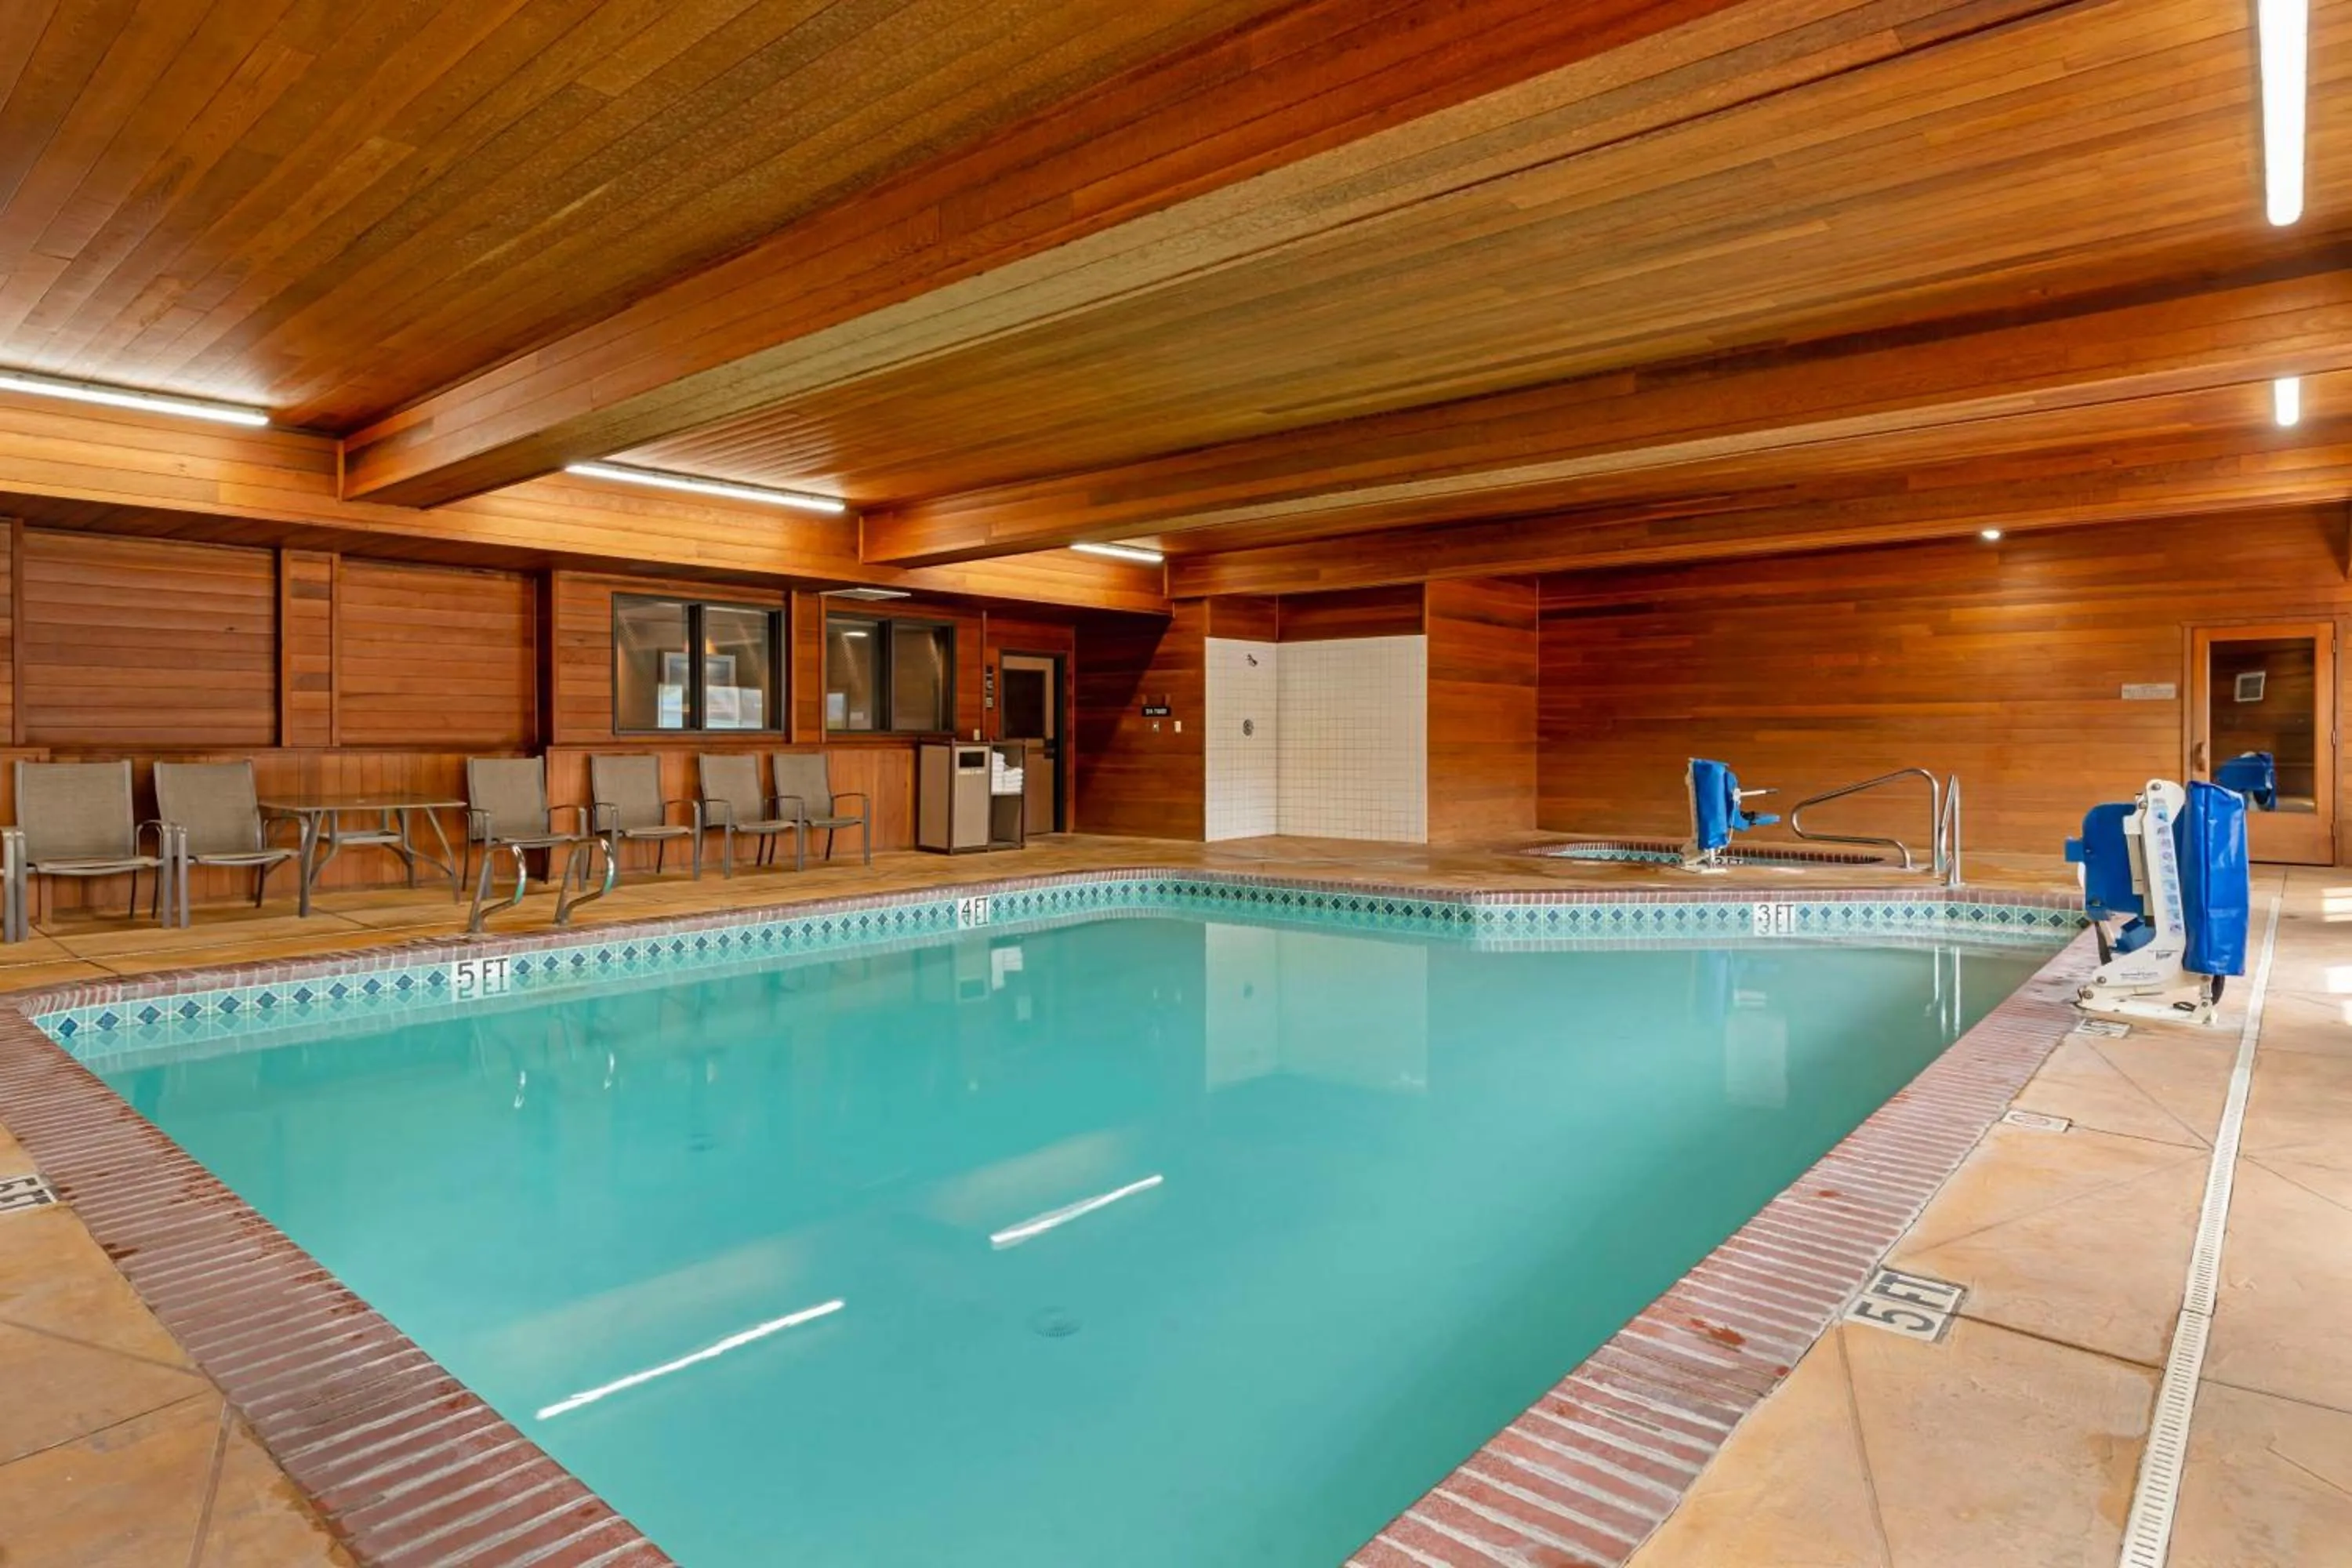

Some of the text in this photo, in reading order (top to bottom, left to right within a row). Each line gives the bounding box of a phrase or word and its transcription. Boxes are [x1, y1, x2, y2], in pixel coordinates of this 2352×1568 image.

[962, 897, 989, 914] 4 FT
[1759, 904, 1795, 922] 3 FT
[457, 958, 508, 983] 5 FT
[1853, 1272, 1955, 1332] 5 FT
